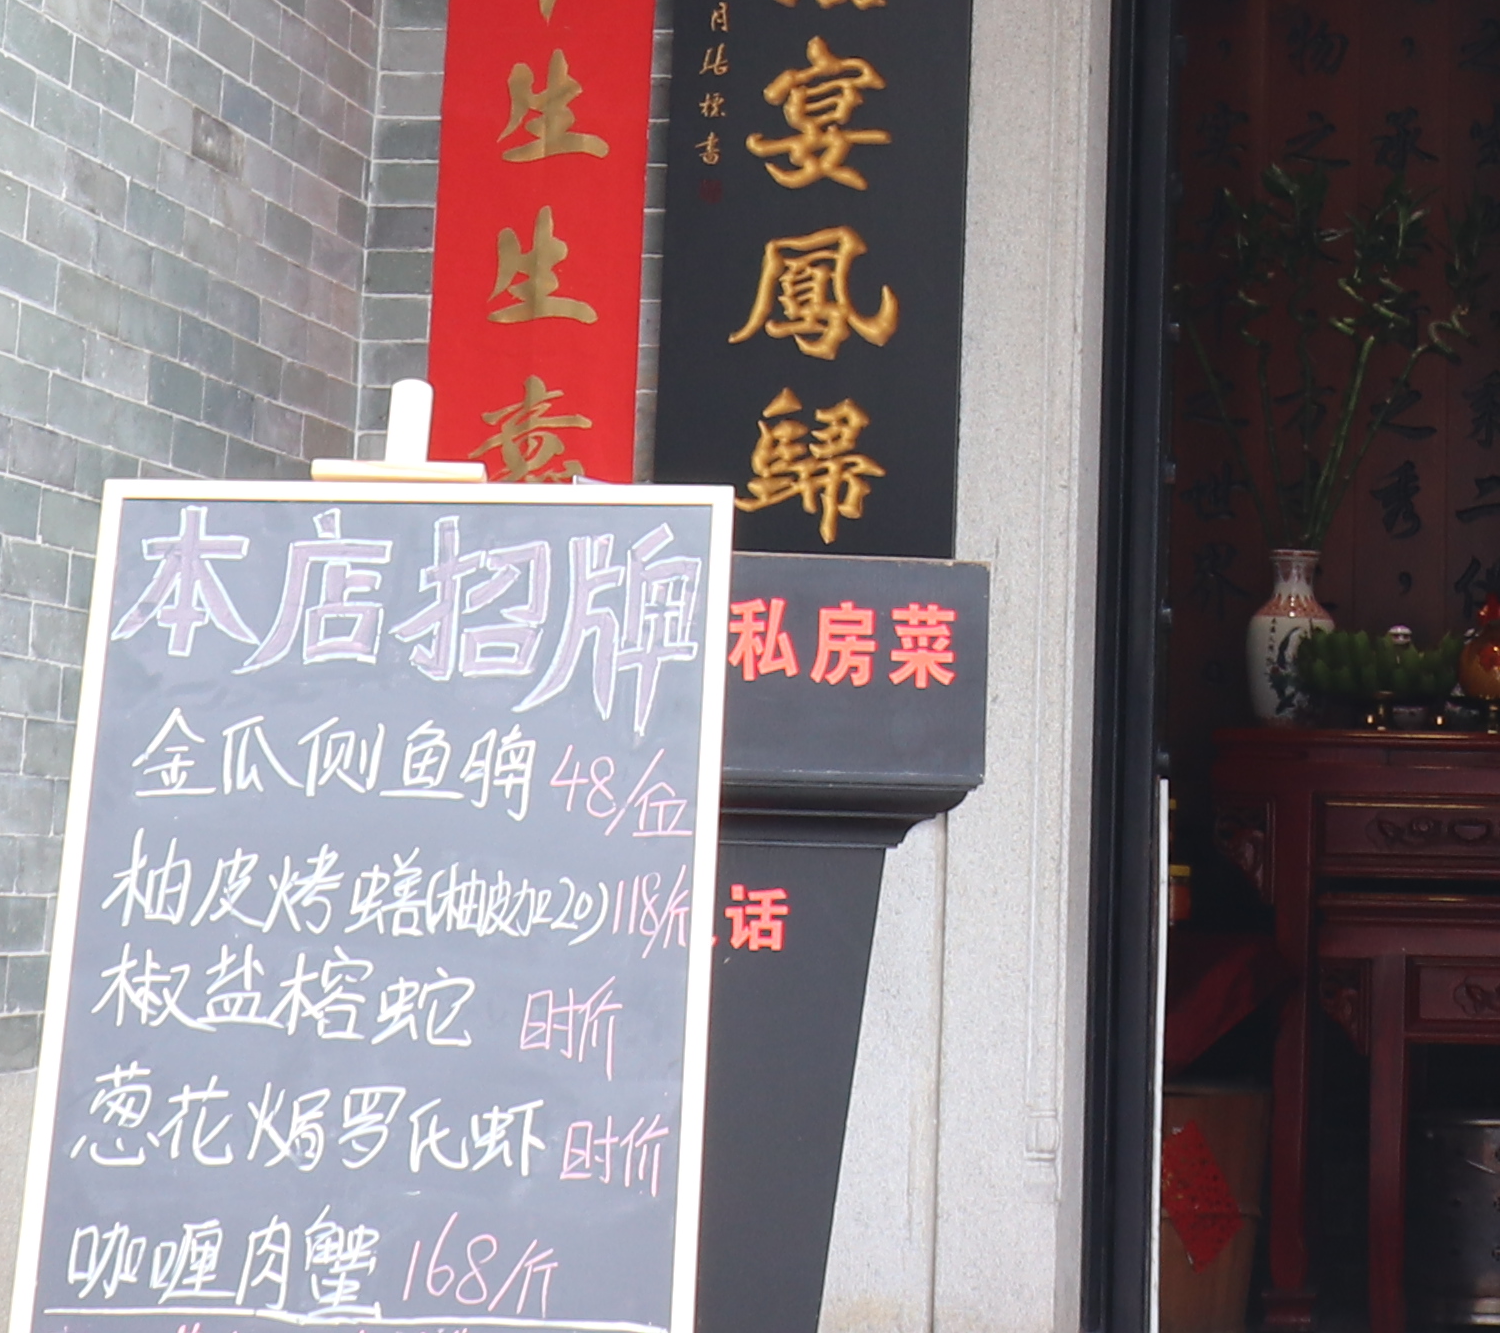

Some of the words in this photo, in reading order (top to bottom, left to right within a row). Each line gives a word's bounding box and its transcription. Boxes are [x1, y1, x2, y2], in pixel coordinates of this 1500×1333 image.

[111, 504, 701, 738] 本店招牌
[728, 598, 958, 689] 私房菜
[711, 883, 790, 952] 话
[519, 974, 623, 1080] 时价
[559, 1113, 671, 1197] 时价
[402, 1212, 559, 1318] 168/斤
